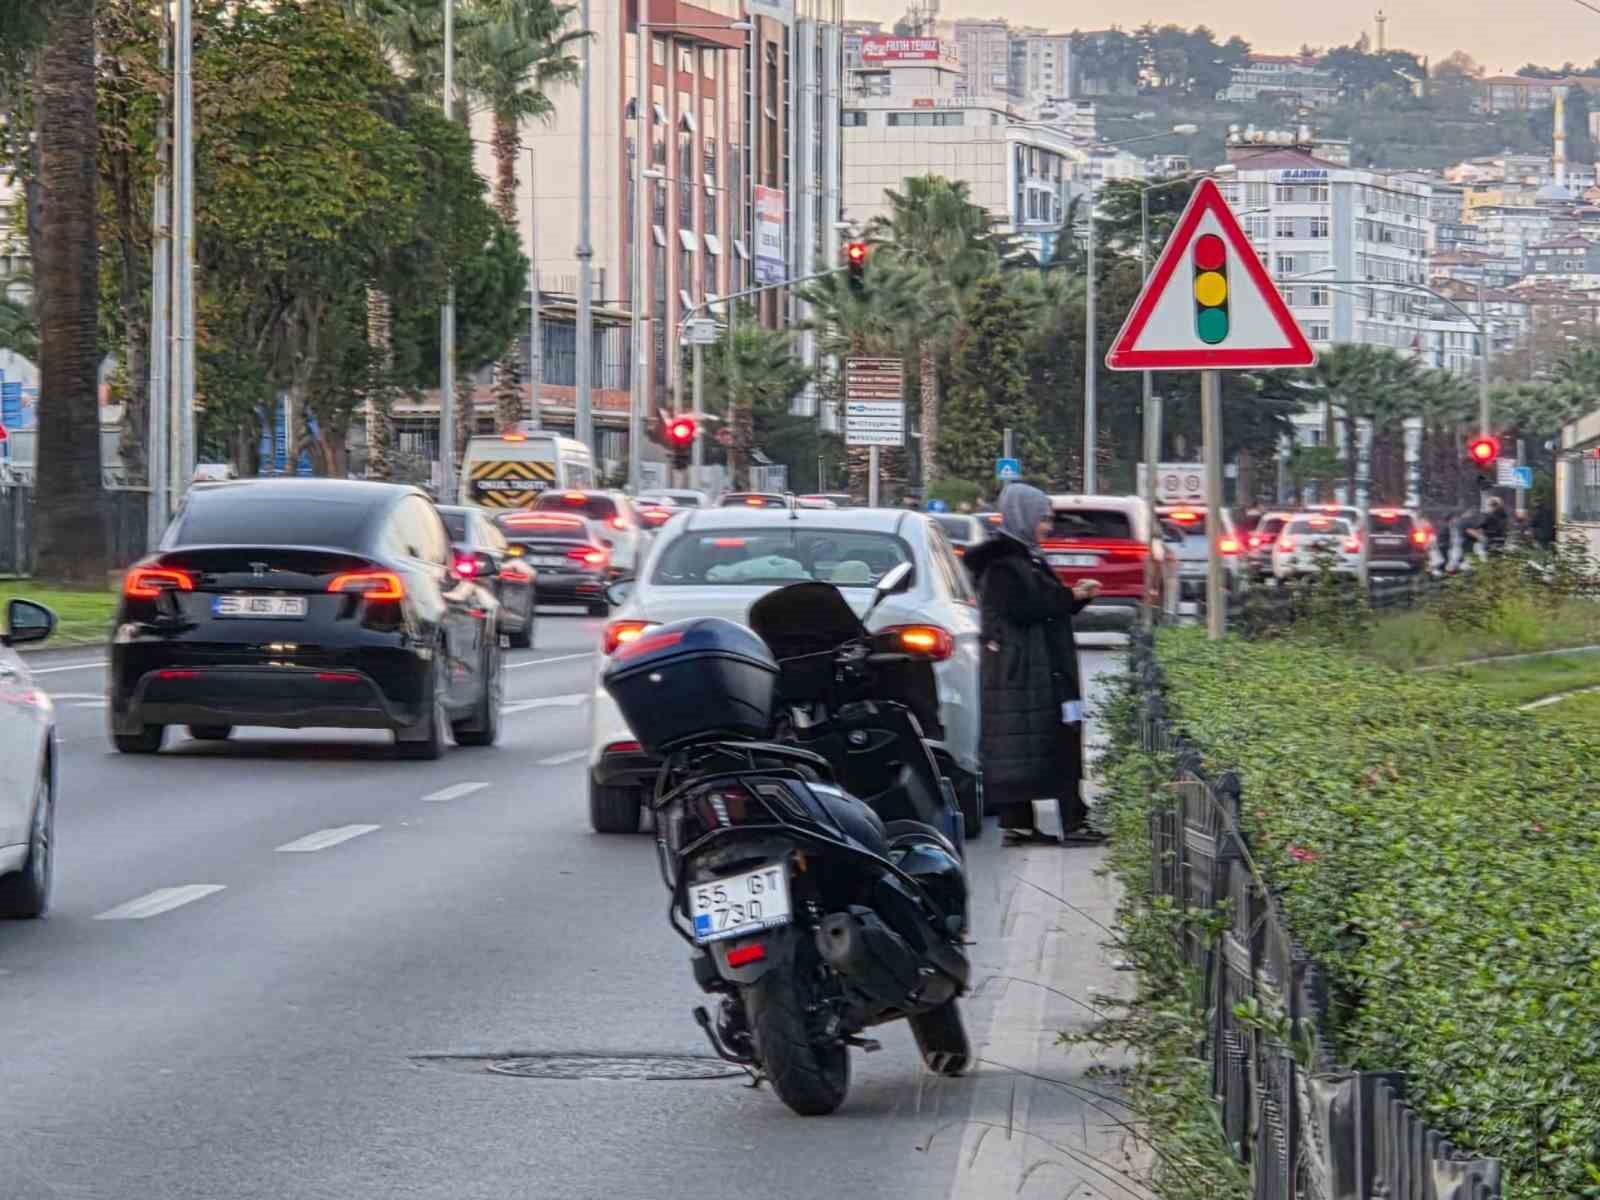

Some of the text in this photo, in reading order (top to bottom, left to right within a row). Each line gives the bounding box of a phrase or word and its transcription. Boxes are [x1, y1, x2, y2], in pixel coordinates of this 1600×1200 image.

[697, 870, 778, 909] 55 GT
[713, 900, 763, 929] 730
